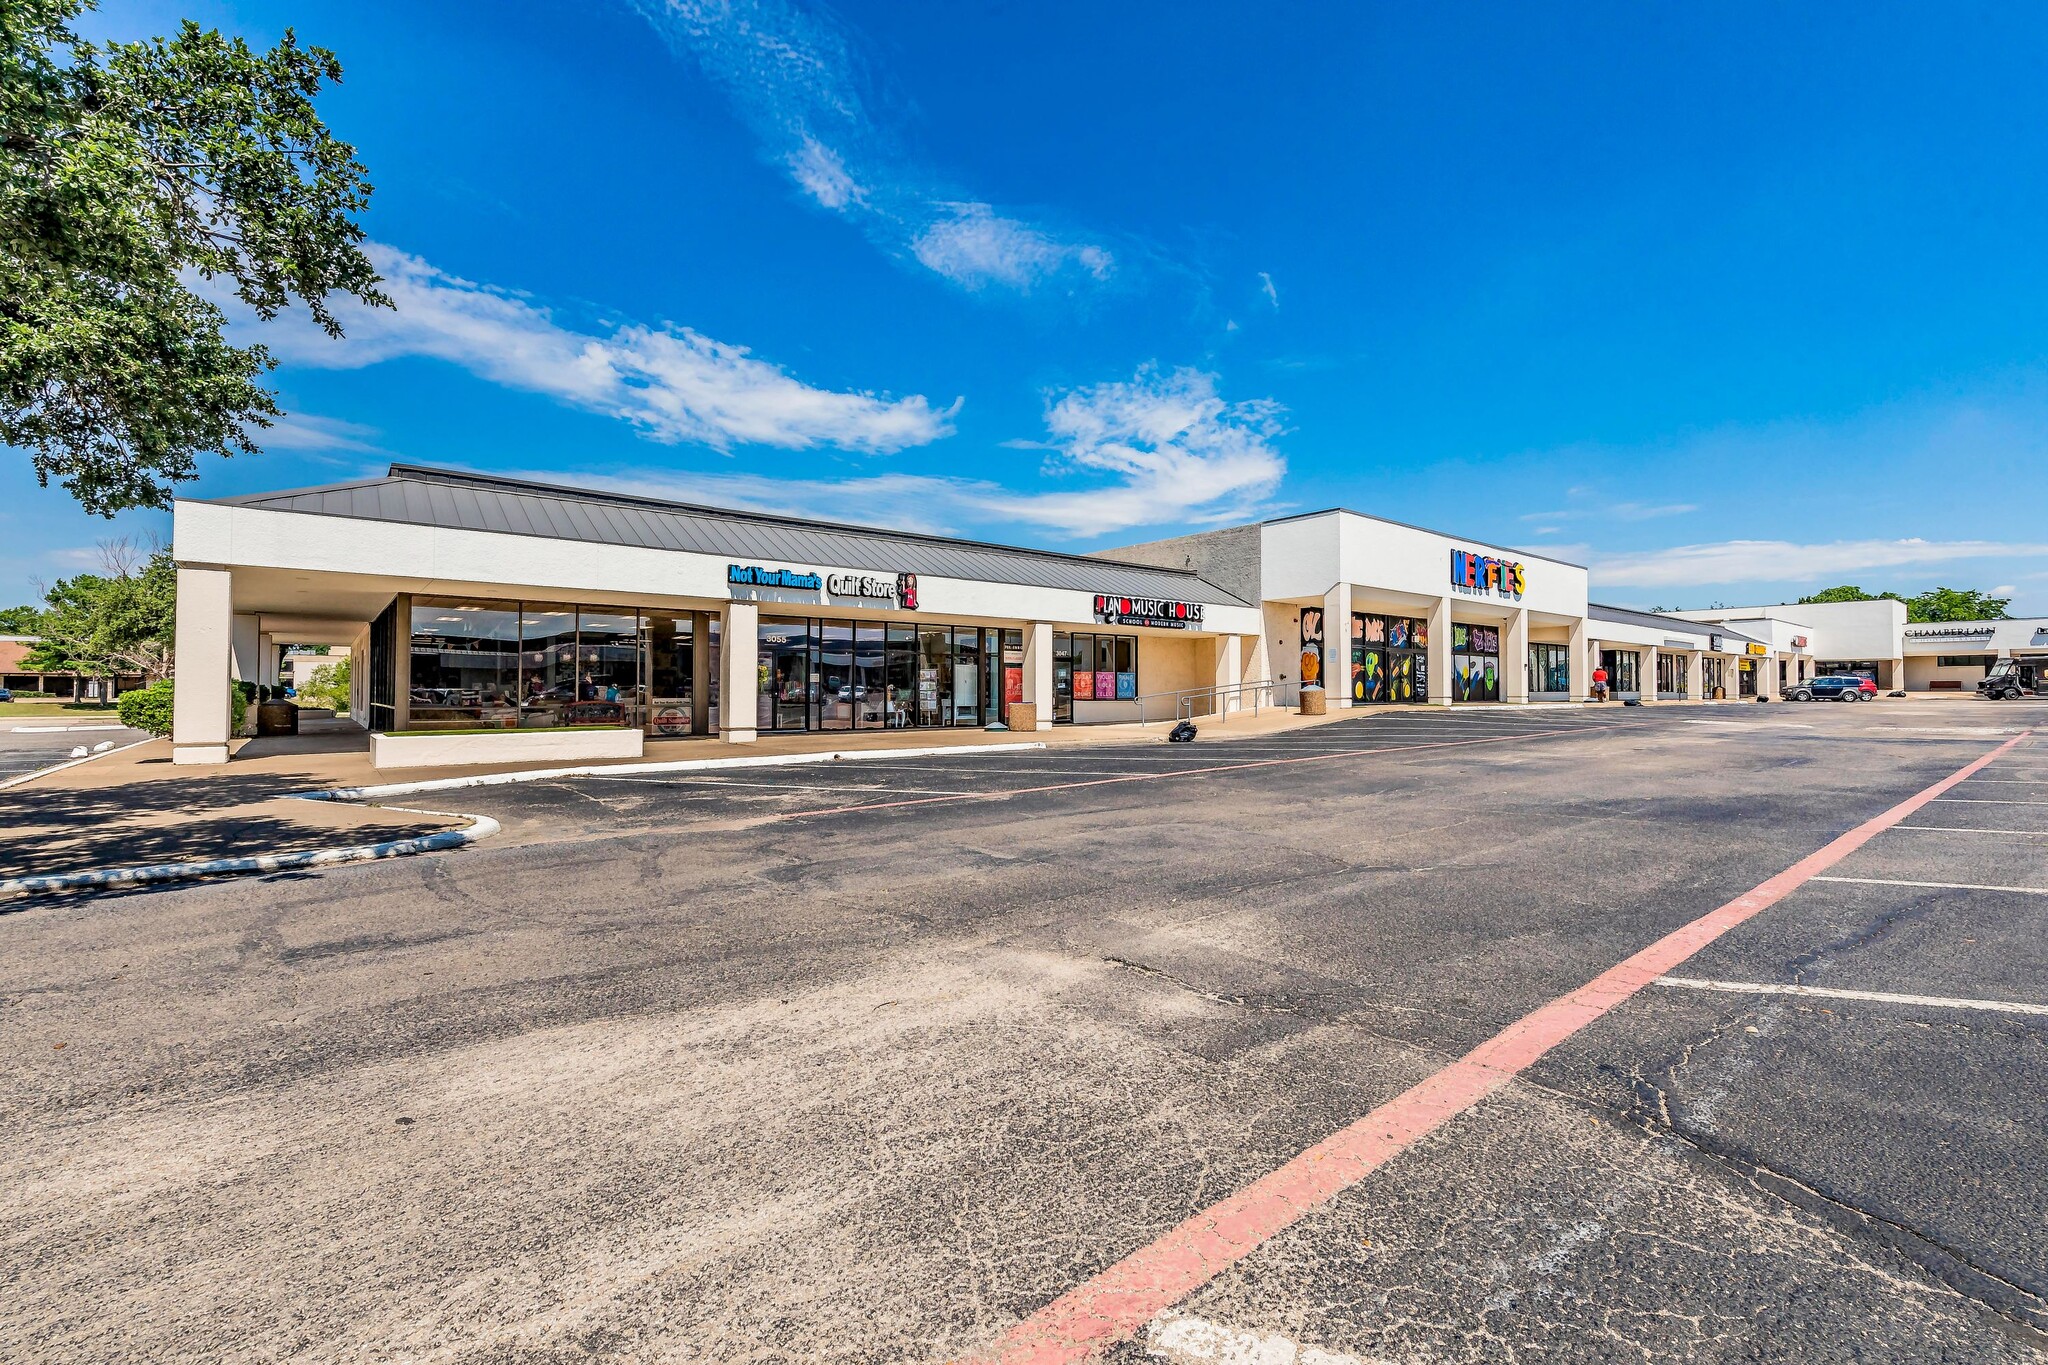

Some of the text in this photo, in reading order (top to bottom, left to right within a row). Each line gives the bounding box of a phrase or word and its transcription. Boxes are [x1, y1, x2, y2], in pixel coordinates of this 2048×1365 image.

[729, 565, 822, 589] Not Your Mama's
[1451, 549, 1526, 595] NERFIES
[829, 574, 897, 598] Quilt Store
[1095, 596, 1205, 620] PLANO MUSIC HOUSE
[766, 635, 787, 643] 3055
[1904, 626, 1996, 637] CHAMBERLAIN
